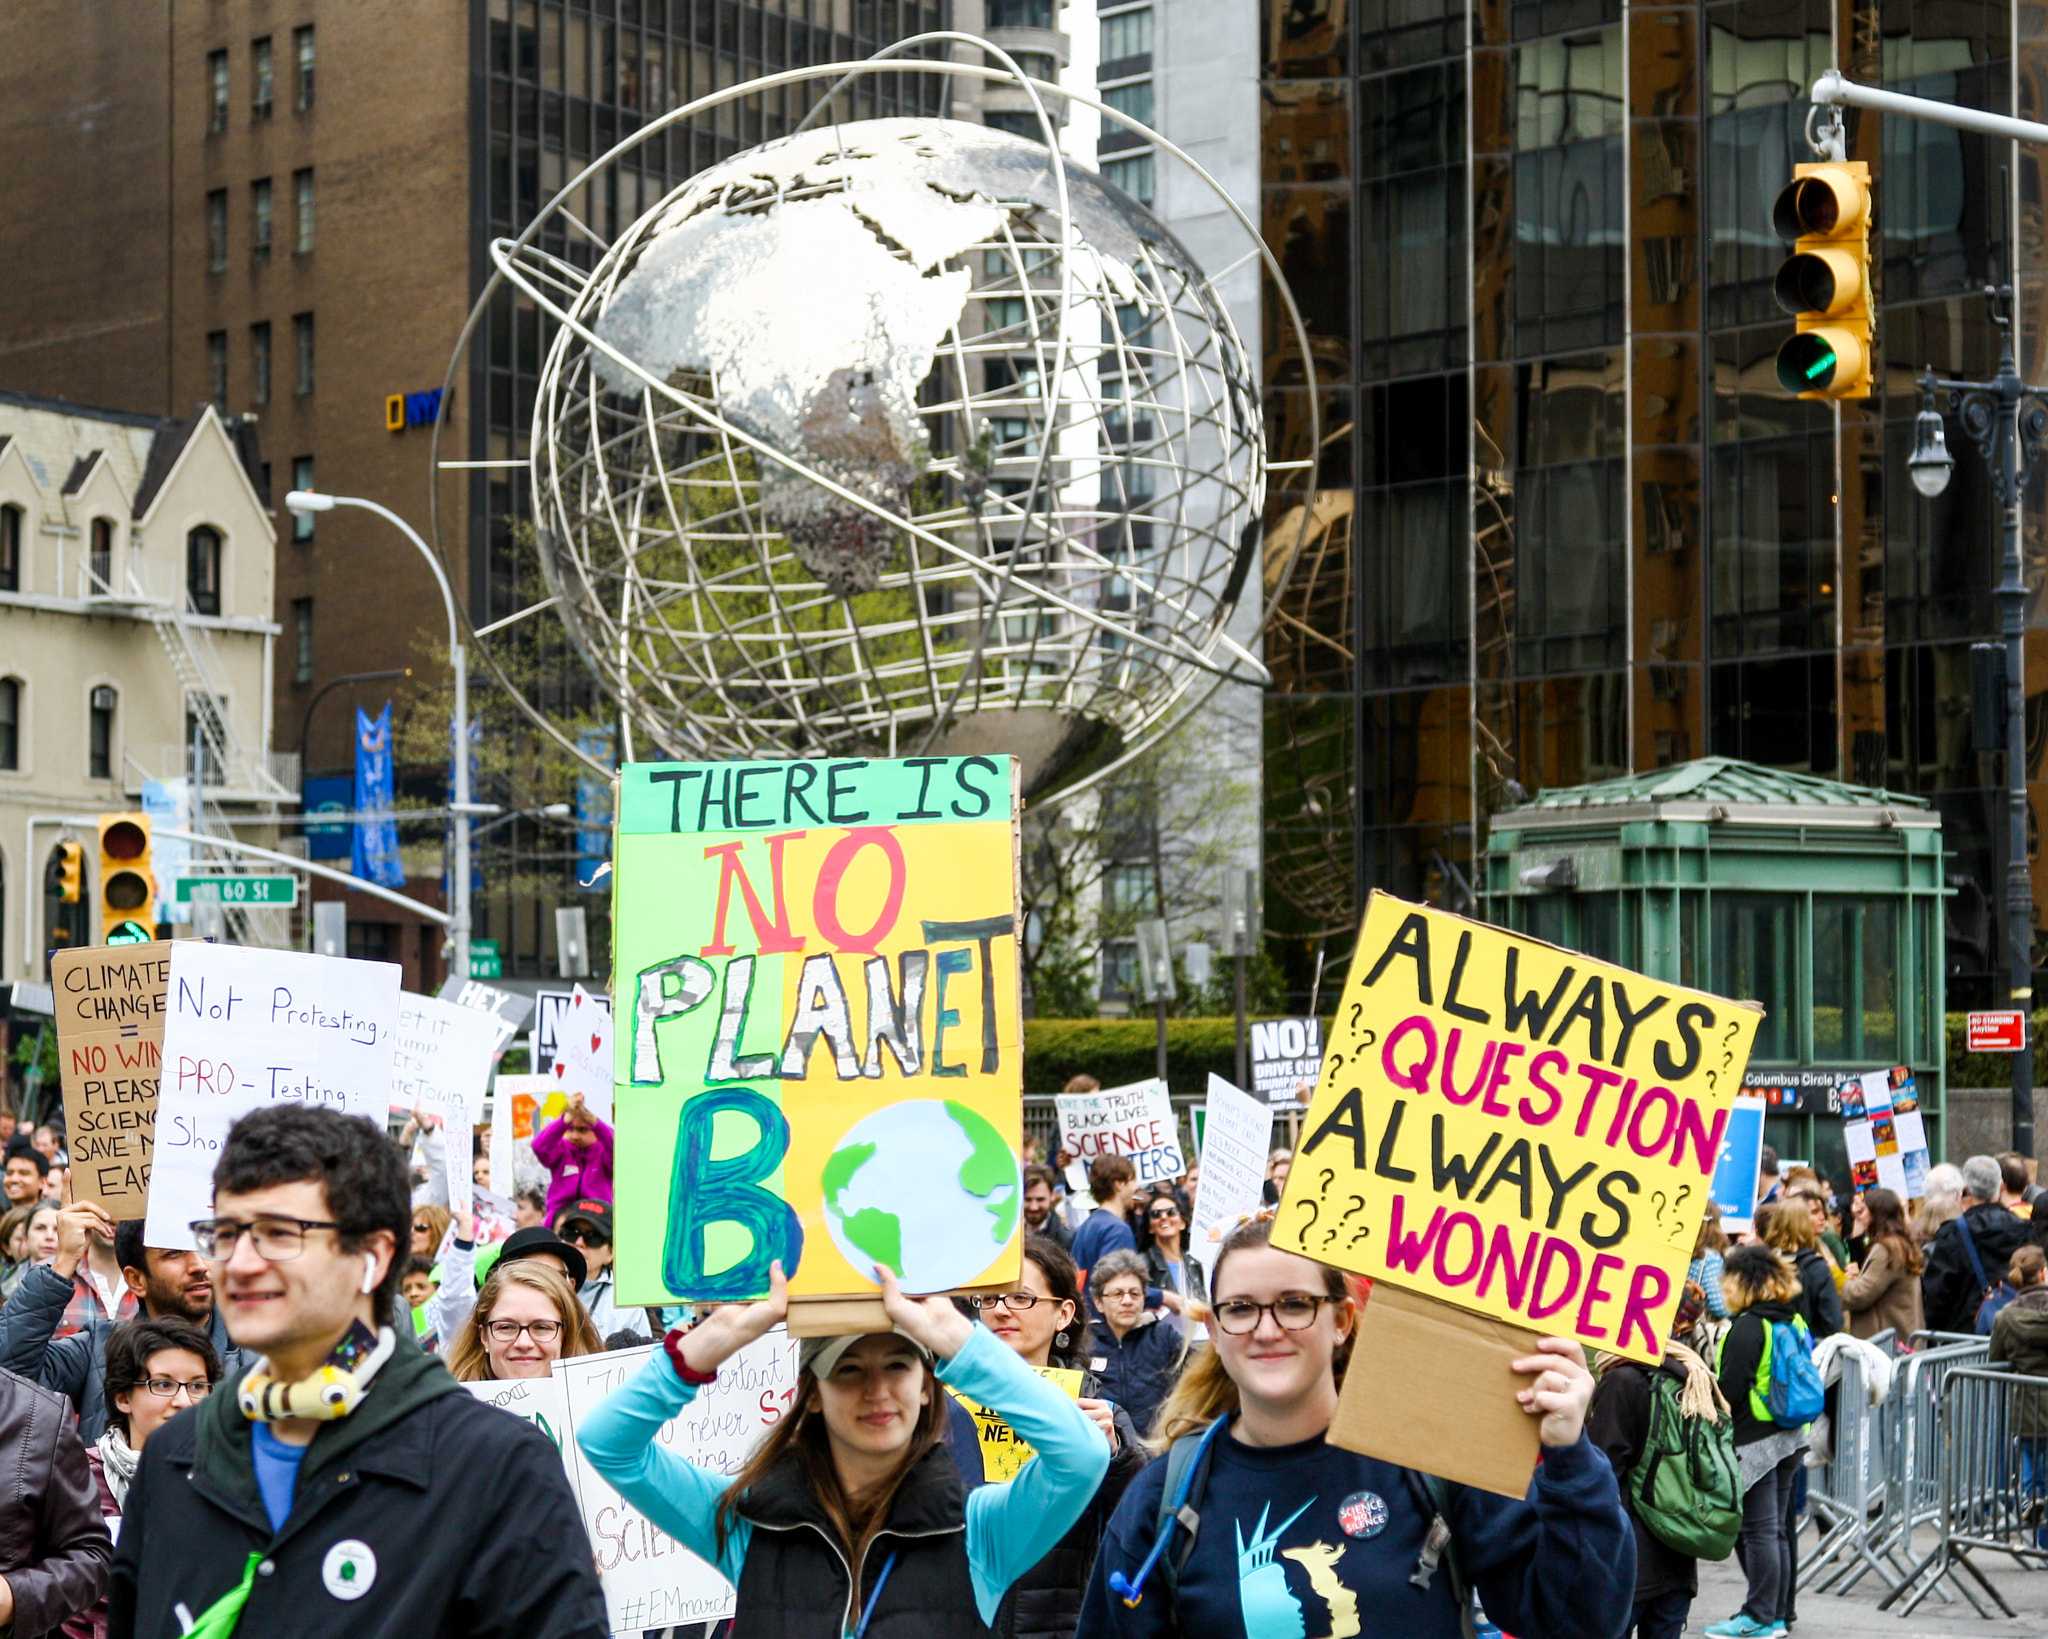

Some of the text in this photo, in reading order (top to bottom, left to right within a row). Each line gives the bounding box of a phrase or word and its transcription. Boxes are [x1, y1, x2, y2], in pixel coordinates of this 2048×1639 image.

[650, 756, 999, 832] THERE IS
[223, 881, 246, 900] 60
[253, 881, 269, 900] St
[700, 824, 907, 957] NO
[64, 960, 169, 992] CLIMATE
[77, 993, 167, 1022] CHANGE
[179, 976, 388, 1045] Not Protesting,
[457, 980, 510, 1014] HEY
[630, 914, 1016, 1087] PLANET
[1361, 912, 1715, 1081] ALWAYS
[120, 1024, 138, 1037] =
[1350, 1003, 1363, 1036] ?
[1722, 1021, 1741, 1048] ?
[1971, 1016, 2015, 1024] NO STANDING
[1972, 1025, 1999, 1034] Anytime
[397, 1037, 438, 1055] ump
[1251, 1018, 1319, 1061] NO!
[1350, 1029, 1377, 1062] ?
[72, 1041, 162, 1075] NO WIN
[1254, 1058, 1321, 1079] DRIVE OUT
[1327, 1053, 1344, 1087] ?
[1723, 1050, 1734, 1073] ?
[178, 1056, 235, 1095] PRO
[266, 1067, 359, 1113] Testing:
[1269, 1088, 1296, 1101] REGI
[1382, 1015, 1727, 1175] QUESTION
[1706, 1069, 1718, 1096] ?
[1746, 1072, 1799, 1086] Columbus
[1802, 1072, 1833, 1086] Circle
[1105, 1090, 1145, 1108] TRUTH
[167, 1116, 225, 1150] Sho
[1068, 1106, 1149, 1129] BLACK LIVES
[74, 1136, 130, 1162] SAVE
[1067, 1120, 1165, 1158] SCIENCE
[97, 1163, 152, 1196] EAR
[1083, 1146, 1181, 1184] TERS
[1302, 1088, 1640, 1250] ALWAYS
[662, 1087, 804, 1302] B
[1319, 1168, 1336, 1201] ?
[1672, 1184, 1691, 1213] ?
[1296, 1199, 1320, 1251] ?
[1338, 1195, 1367, 1227] ?
[1651, 1190, 1667, 1228] ?
[1322, 1229, 1337, 1251] ?
[1346, 1226, 1371, 1250] ?
[1667, 1221, 1685, 1242] ?
[1385, 1195, 1670, 1355] WONDER
[702, 1346, 783, 1415] portant
[687, 1412, 749, 1443] never
[759, 1387, 797, 1426] ST
[1341, 1499, 1384, 1518] SCIENCE
[1346, 1514, 1385, 1533] SILENCE
[1354, 1511, 1372, 1522] NOT
[596, 1507, 688, 1570] SCIE
